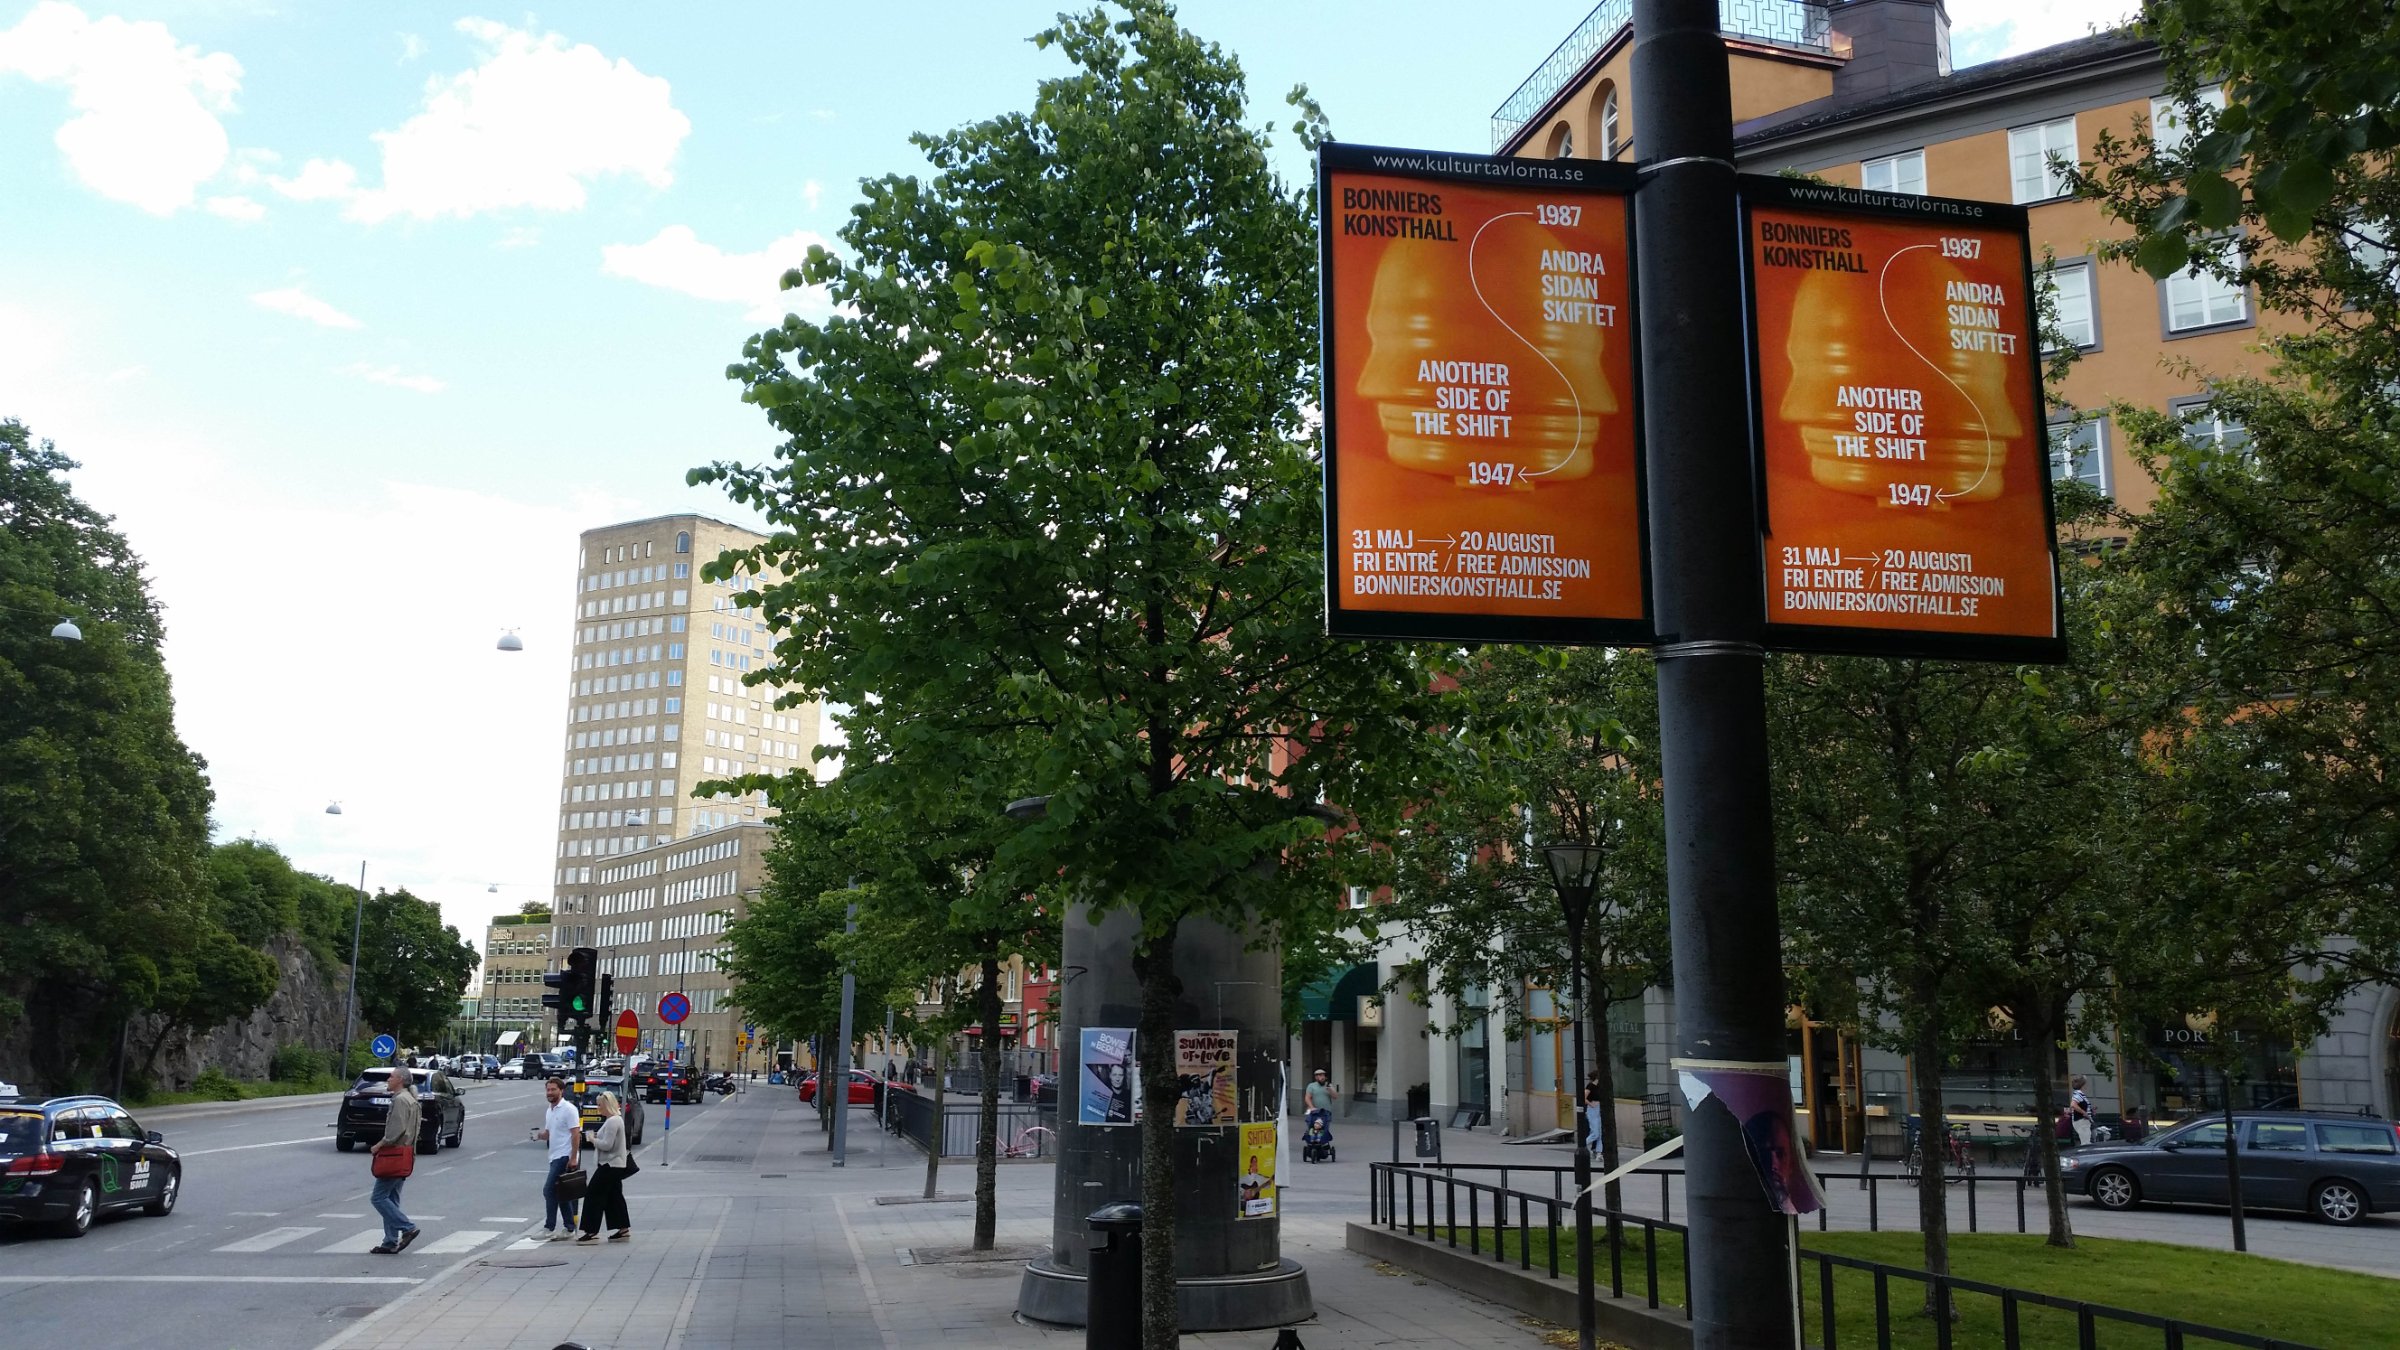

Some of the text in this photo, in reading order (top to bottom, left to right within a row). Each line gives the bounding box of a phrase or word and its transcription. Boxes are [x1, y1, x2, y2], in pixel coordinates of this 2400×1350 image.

[1373, 154, 1584, 181] www.kulturtavlorna.se
[1343, 187, 1443, 215] BONNIERS
[1789, 187, 1983, 218] www.kulturtavlorna.se
[1343, 213, 1458, 242] KONSTHALL
[1536, 204, 1582, 227] 1987
[1761, 221, 1852, 249] BONNIERS
[1763, 246, 1868, 273] KONSTHALL
[1939, 237, 1981, 260] 1987
[1539, 249, 1606, 275] ANDRA
[1541, 274, 1599, 300] SIDAN
[1945, 280, 2005, 306] ANDRA
[1543, 300, 1616, 327] SKIFTET
[1947, 305, 2000, 329] SIDAN
[1950, 328, 2016, 355] SKIFTET
[1417, 359, 1509, 386] ANOTHER
[1436, 386, 1511, 411] SIDE OF
[1836, 386, 1923, 411] ANOTHER
[1411, 411, 1512, 438] THE SHIFT
[1855, 411, 1925, 436] SIDE OF
[1833, 435, 1927, 461] THE SHIFT
[1468, 461, 1515, 485] 1947
[1888, 483, 1932, 506] 1947
[1352, 529, 1555, 554] 31 MAJ 20 AUGUSTI
[1353, 552, 1380, 572] FRI
[1385, 550, 1438, 573] ENTRÉ
[1457, 554, 1496, 575] FREE
[1500, 555, 1590, 579] ADMISSION
[1782, 547, 1972, 573] 31 MAJ 20 AUGUSTI
[1353, 575, 1562, 600] BONNIERSKONSTHALL.SE
[1783, 569, 1809, 588] FRI
[1813, 567, 1864, 590] ENTRÉ
[1881, 571, 1918, 592] FREE
[1921, 572, 2004, 596] ADMISSION
[1784, 591, 1979, 617] BONNIERSKONSTHALL.SE
[1095, 1040, 1125, 1058] BERLIN
[1100, 1033, 1127, 1050] BOWIE
